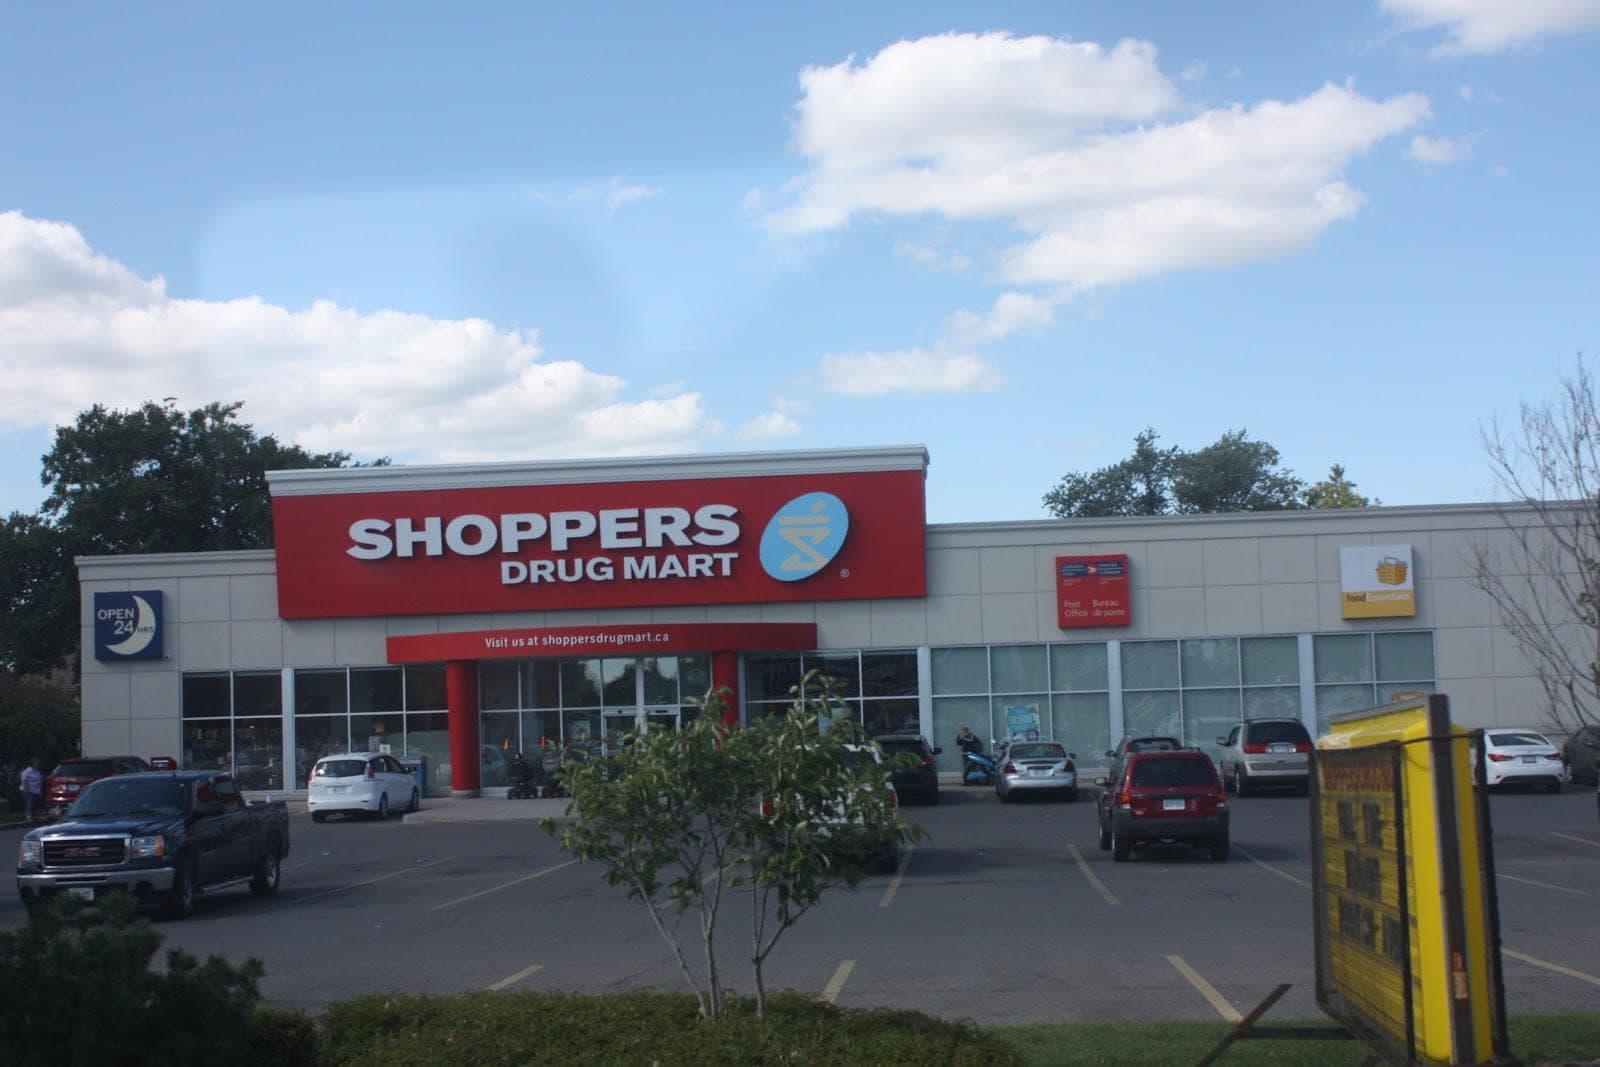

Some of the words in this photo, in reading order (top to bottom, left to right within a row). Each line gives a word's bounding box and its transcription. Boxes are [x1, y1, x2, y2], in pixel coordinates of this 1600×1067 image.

[346, 503, 741, 560] SHOPPERS
[500, 556, 614, 585] DRUG
[622, 551, 739, 581] MART
[1063, 600, 1081, 608] Post
[1092, 599, 1119, 607] Bureau
[97, 608, 135, 620] OPEN
[1064, 609, 1088, 617] Office
[1092, 609, 1103, 617] de
[1104, 609, 1126, 619] poste
[113, 620, 135, 635] 24
[485, 636, 508, 648] Visit
[511, 637, 525, 647] us
[527, 635, 539, 647] at
[542, 631, 670, 648] shoppersdrugmart.ca
